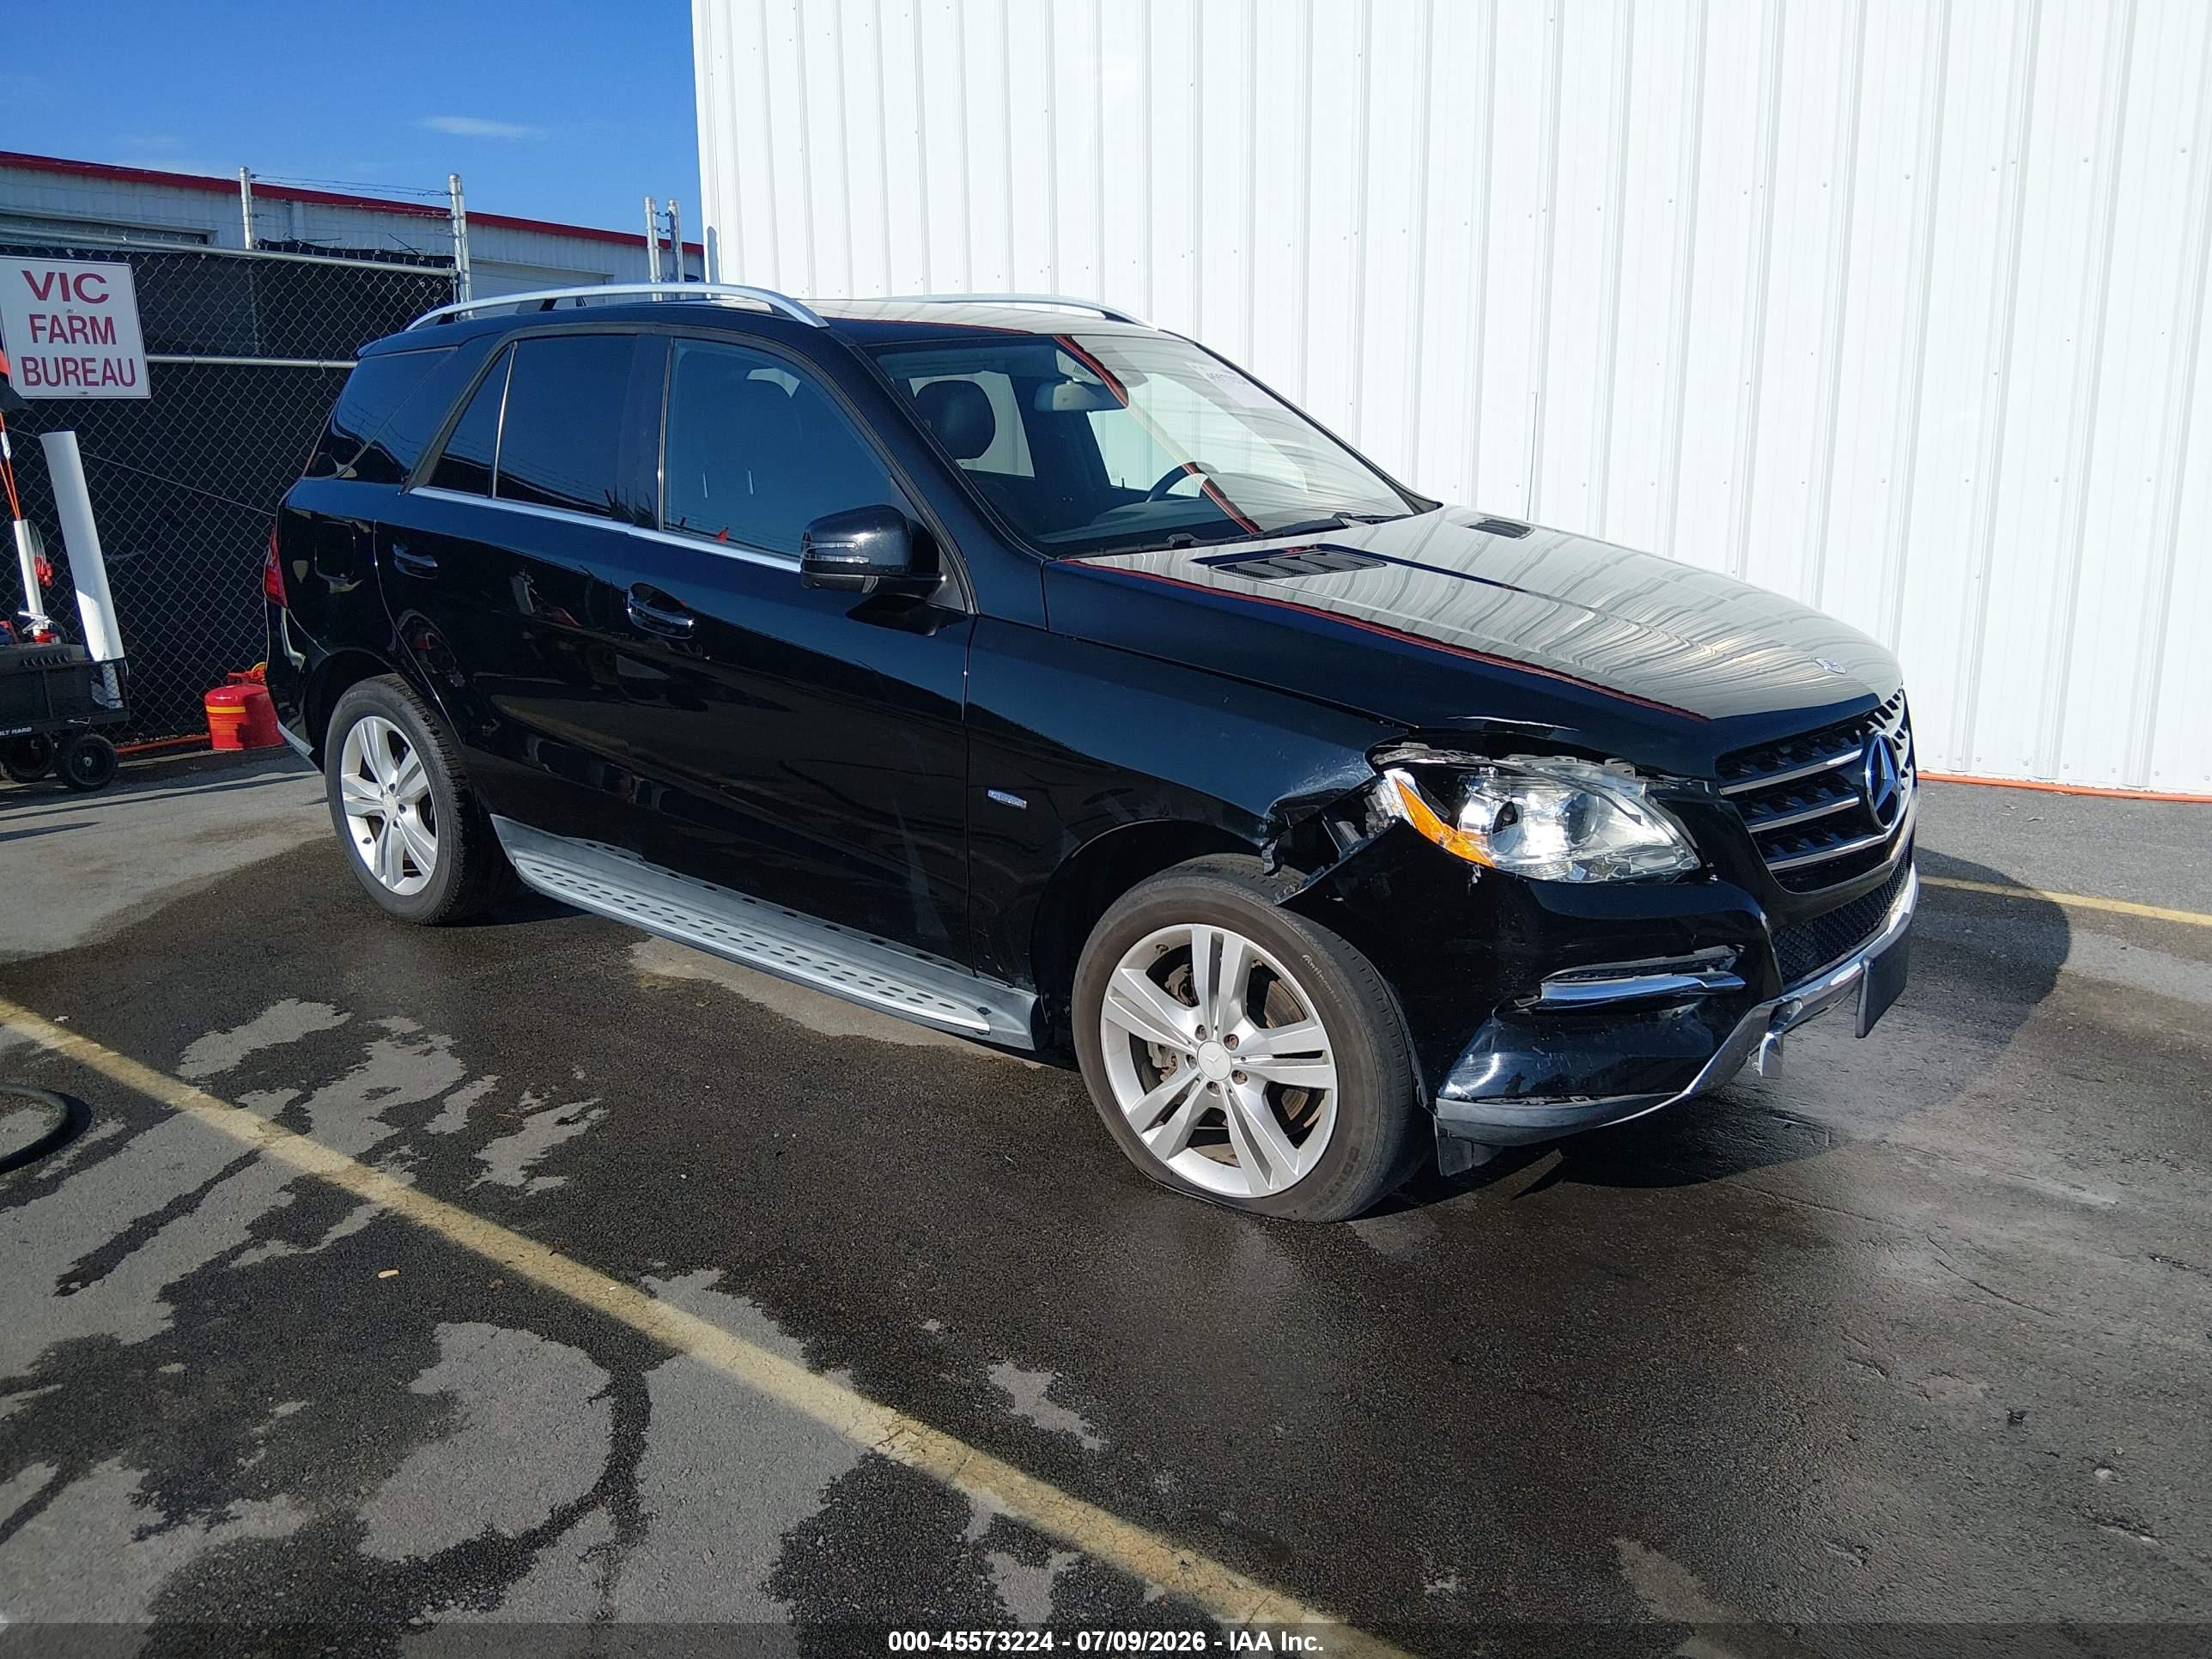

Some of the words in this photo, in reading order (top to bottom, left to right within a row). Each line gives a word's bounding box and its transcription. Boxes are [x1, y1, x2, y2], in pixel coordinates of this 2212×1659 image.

[21, 270, 109, 304] VIC
[28, 313, 117, 345] FARM
[21, 356, 137, 387] BUREAU
